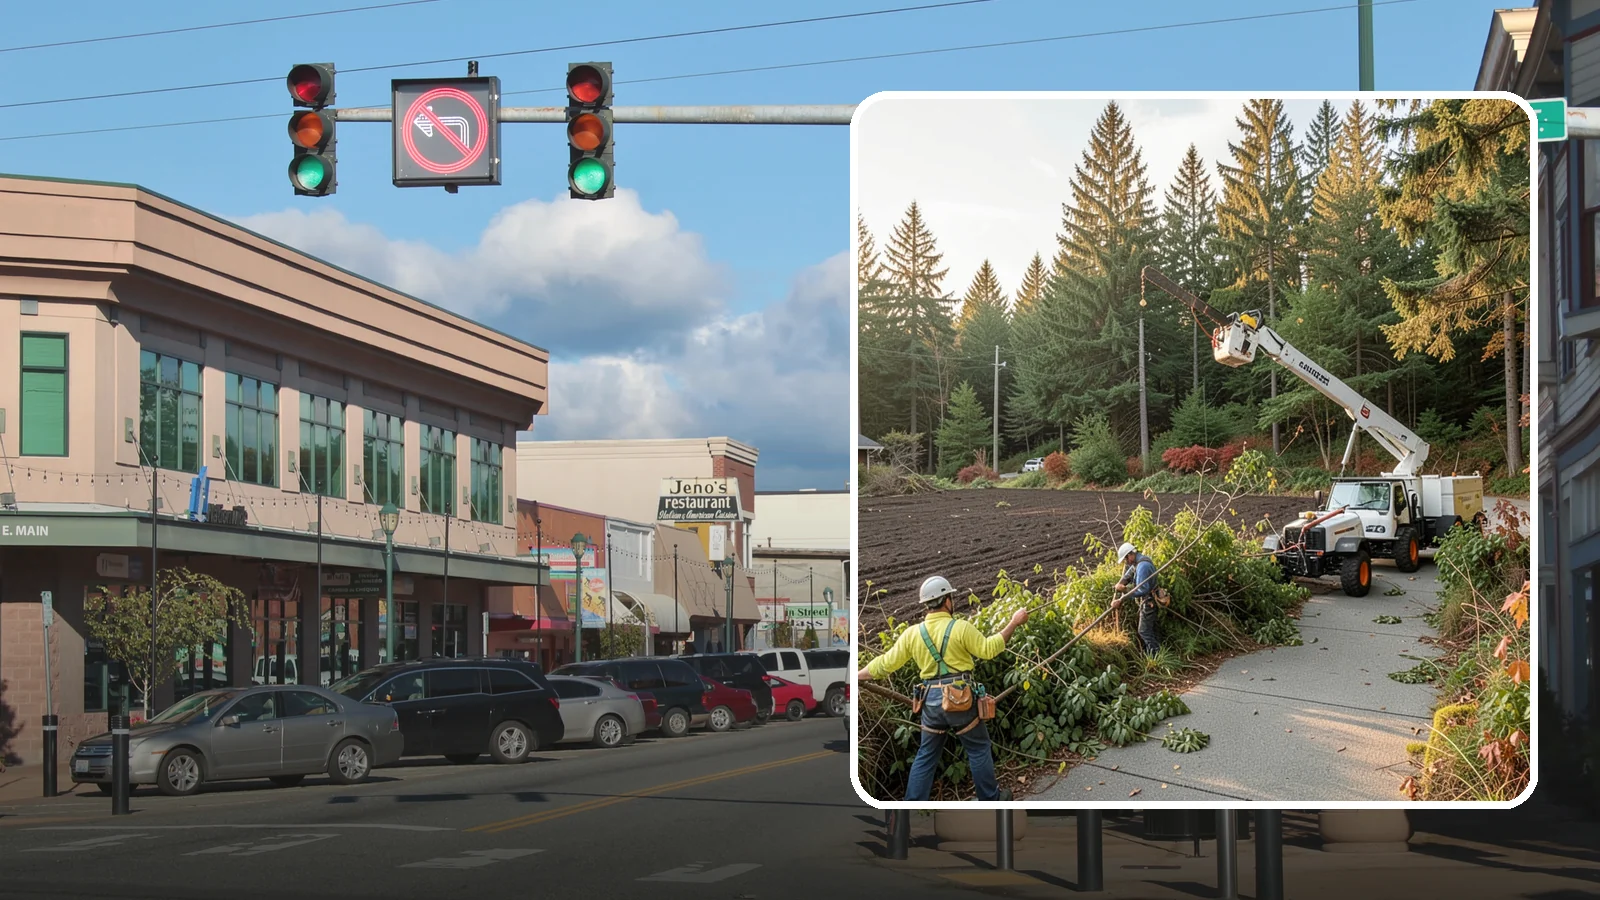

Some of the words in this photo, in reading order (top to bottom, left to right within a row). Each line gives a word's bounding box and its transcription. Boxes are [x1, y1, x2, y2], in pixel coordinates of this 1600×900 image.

[670, 480, 727, 494] Jeno's
[665, 496, 731, 509] restaurant
[659, 510, 682, 520] Italian
[686, 510, 715, 519] American
[715, 509, 737, 519] Cuisine
[2, 525, 13, 536] E.
[16, 525, 49, 536] MAIN
[797, 607, 828, 617] Street
